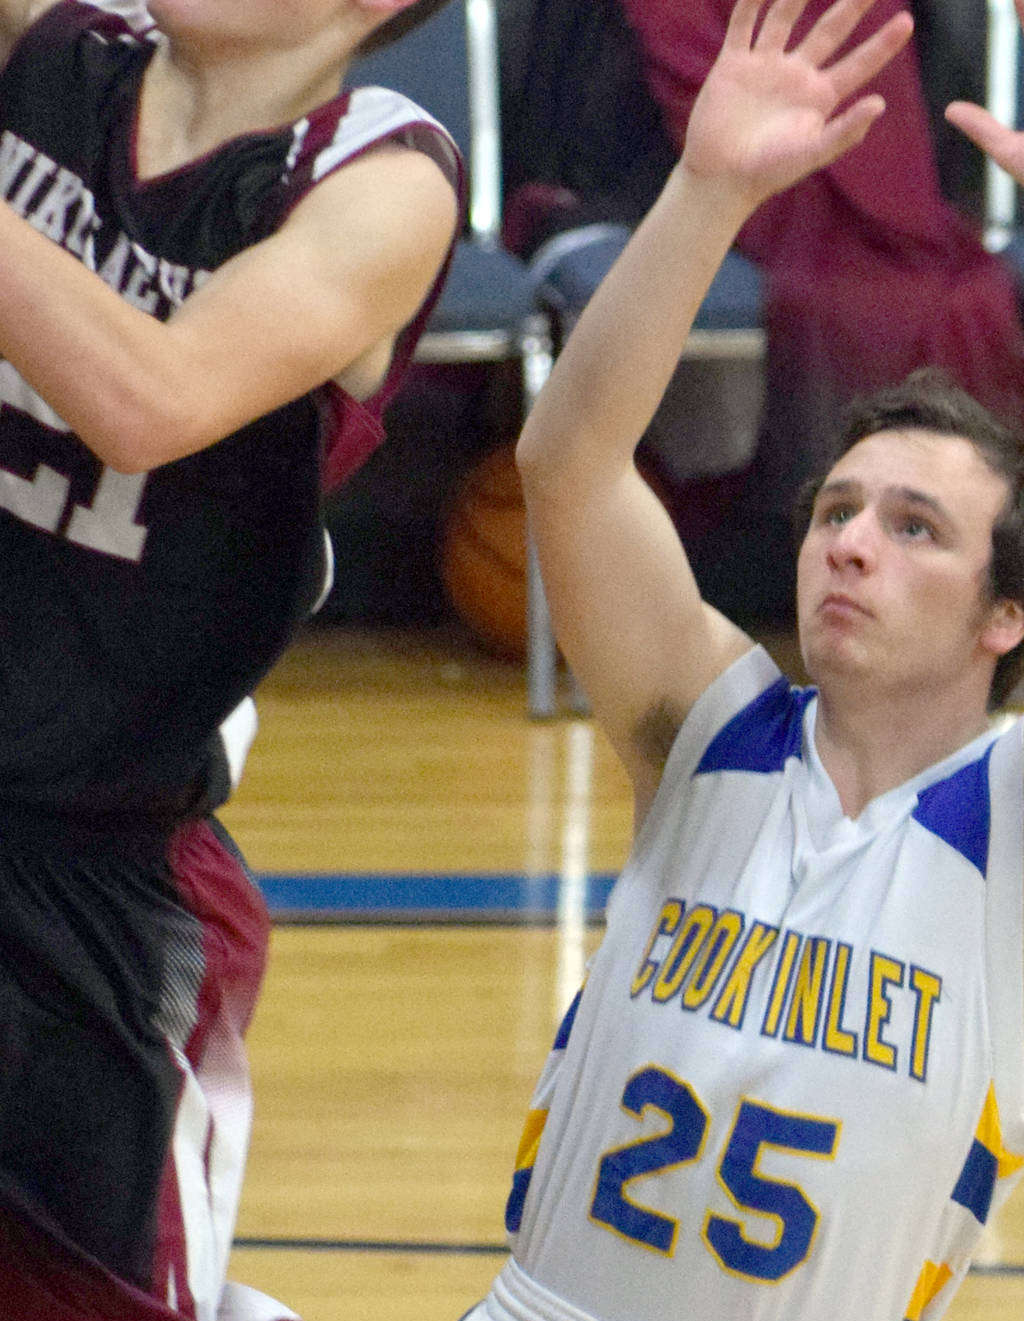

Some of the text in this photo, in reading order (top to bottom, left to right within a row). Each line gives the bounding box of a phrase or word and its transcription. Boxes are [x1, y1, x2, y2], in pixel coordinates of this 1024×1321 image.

[629, 897, 943, 1084] COOK INLET
[587, 1062, 843, 1286] 25
